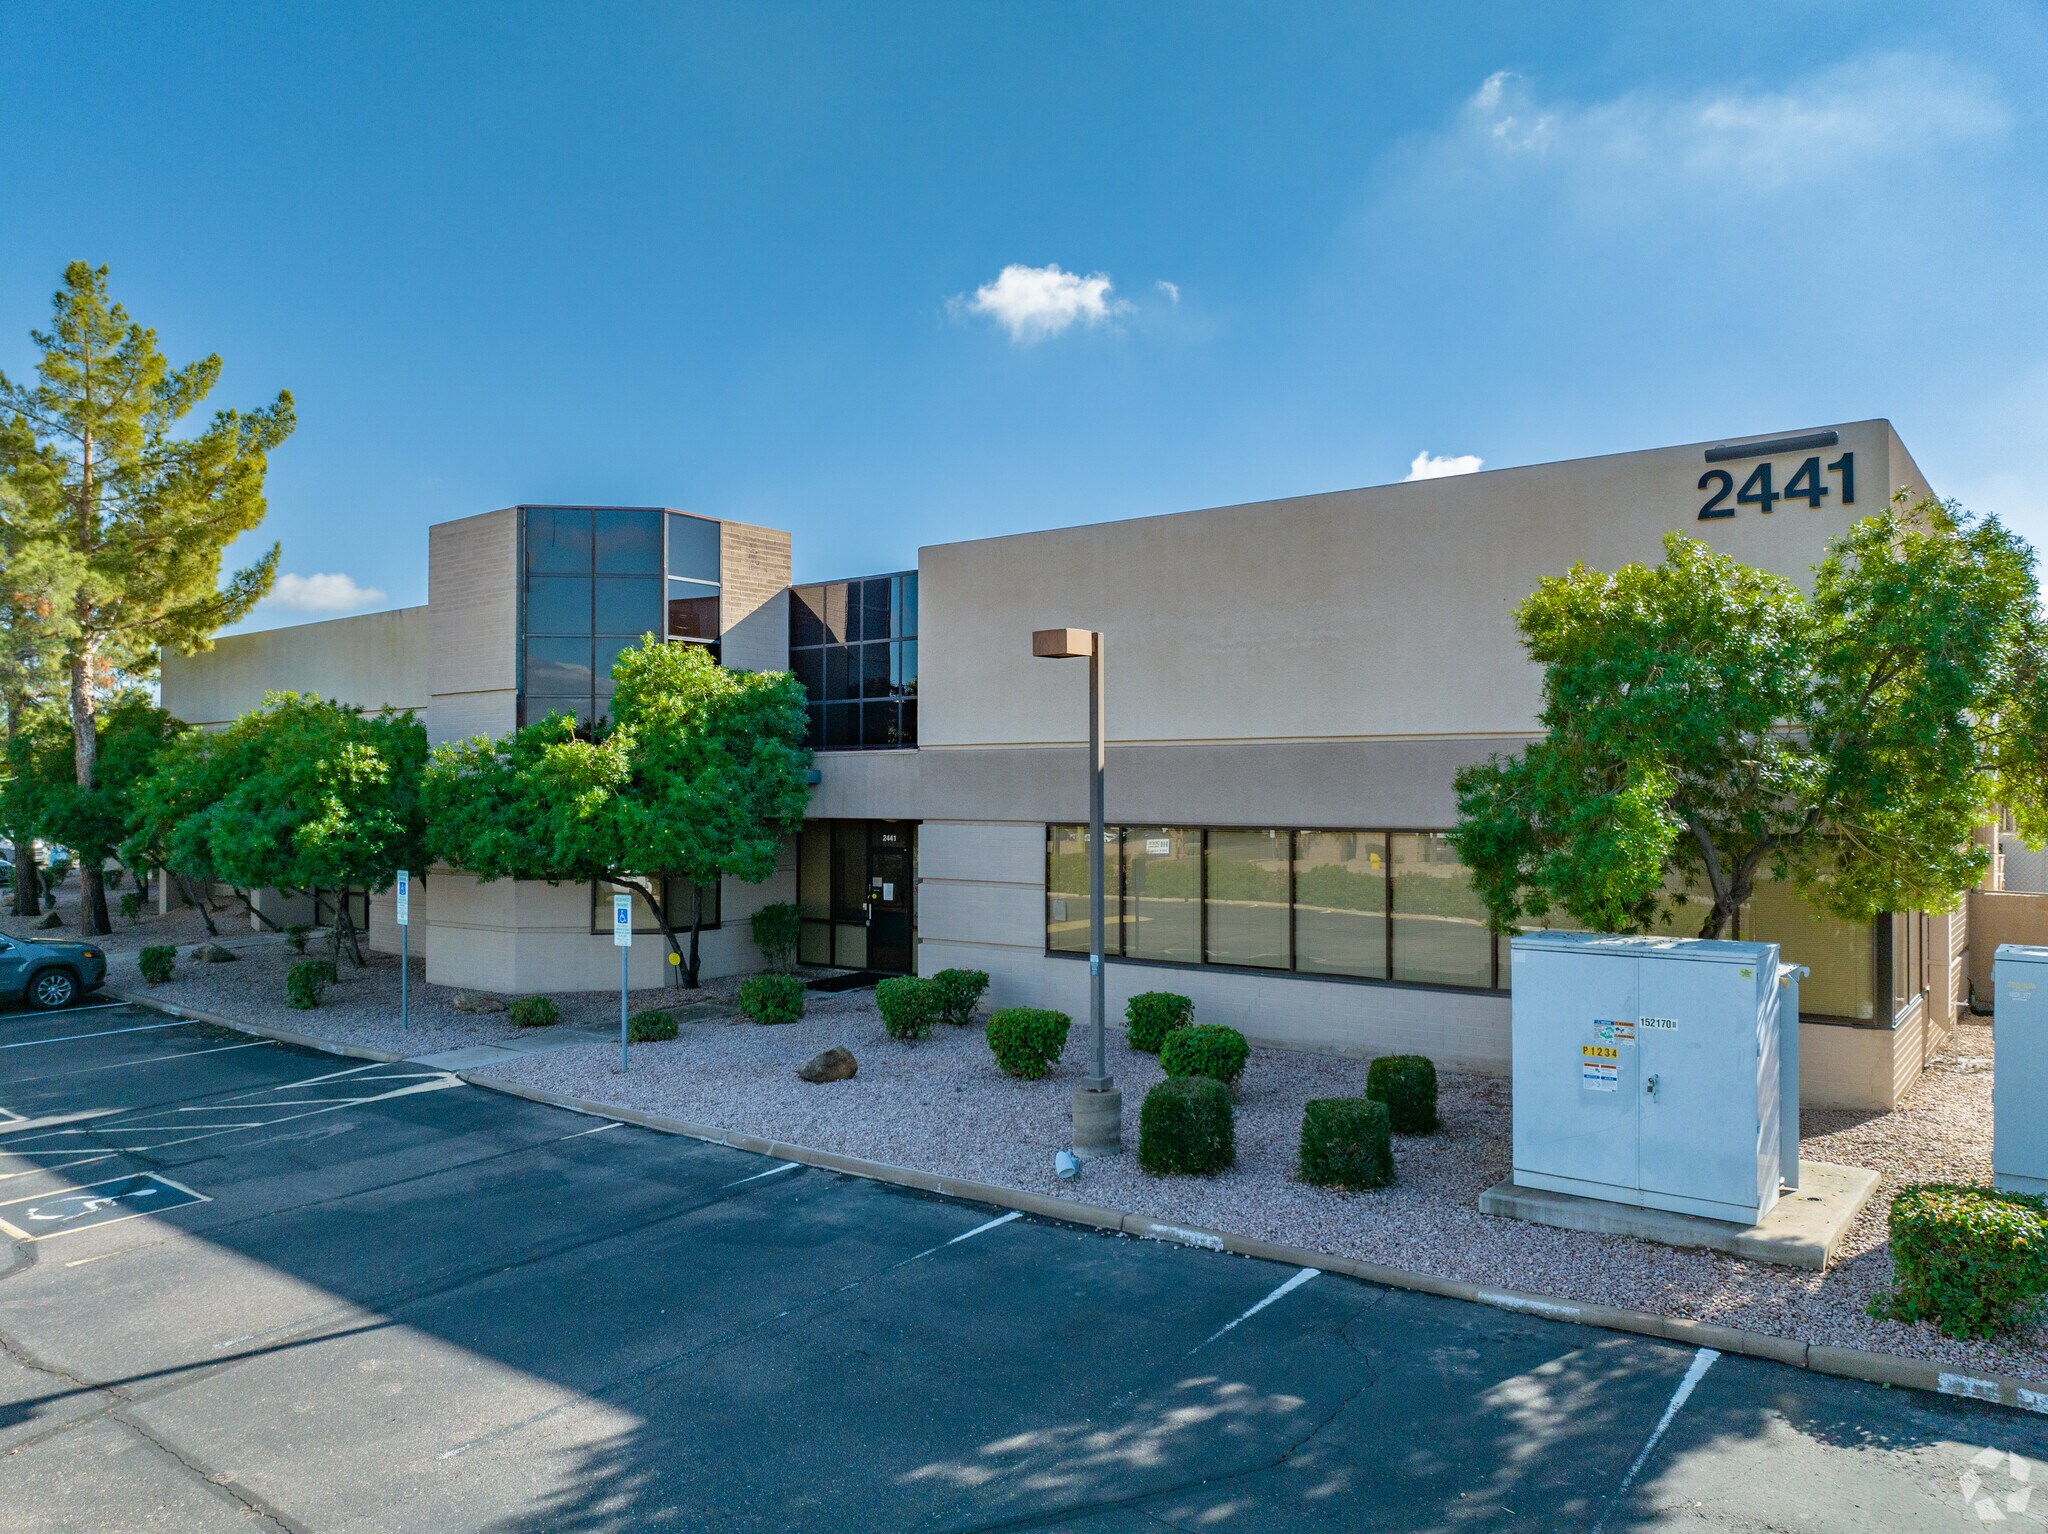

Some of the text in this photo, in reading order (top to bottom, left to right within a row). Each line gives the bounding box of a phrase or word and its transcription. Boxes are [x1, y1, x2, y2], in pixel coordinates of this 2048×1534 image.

[1698, 452, 1855, 520] 2441
[882, 834, 897, 842] 2441
[1640, 1018, 1672, 1029] 152170
[1583, 1046, 1617, 1059] P1234
